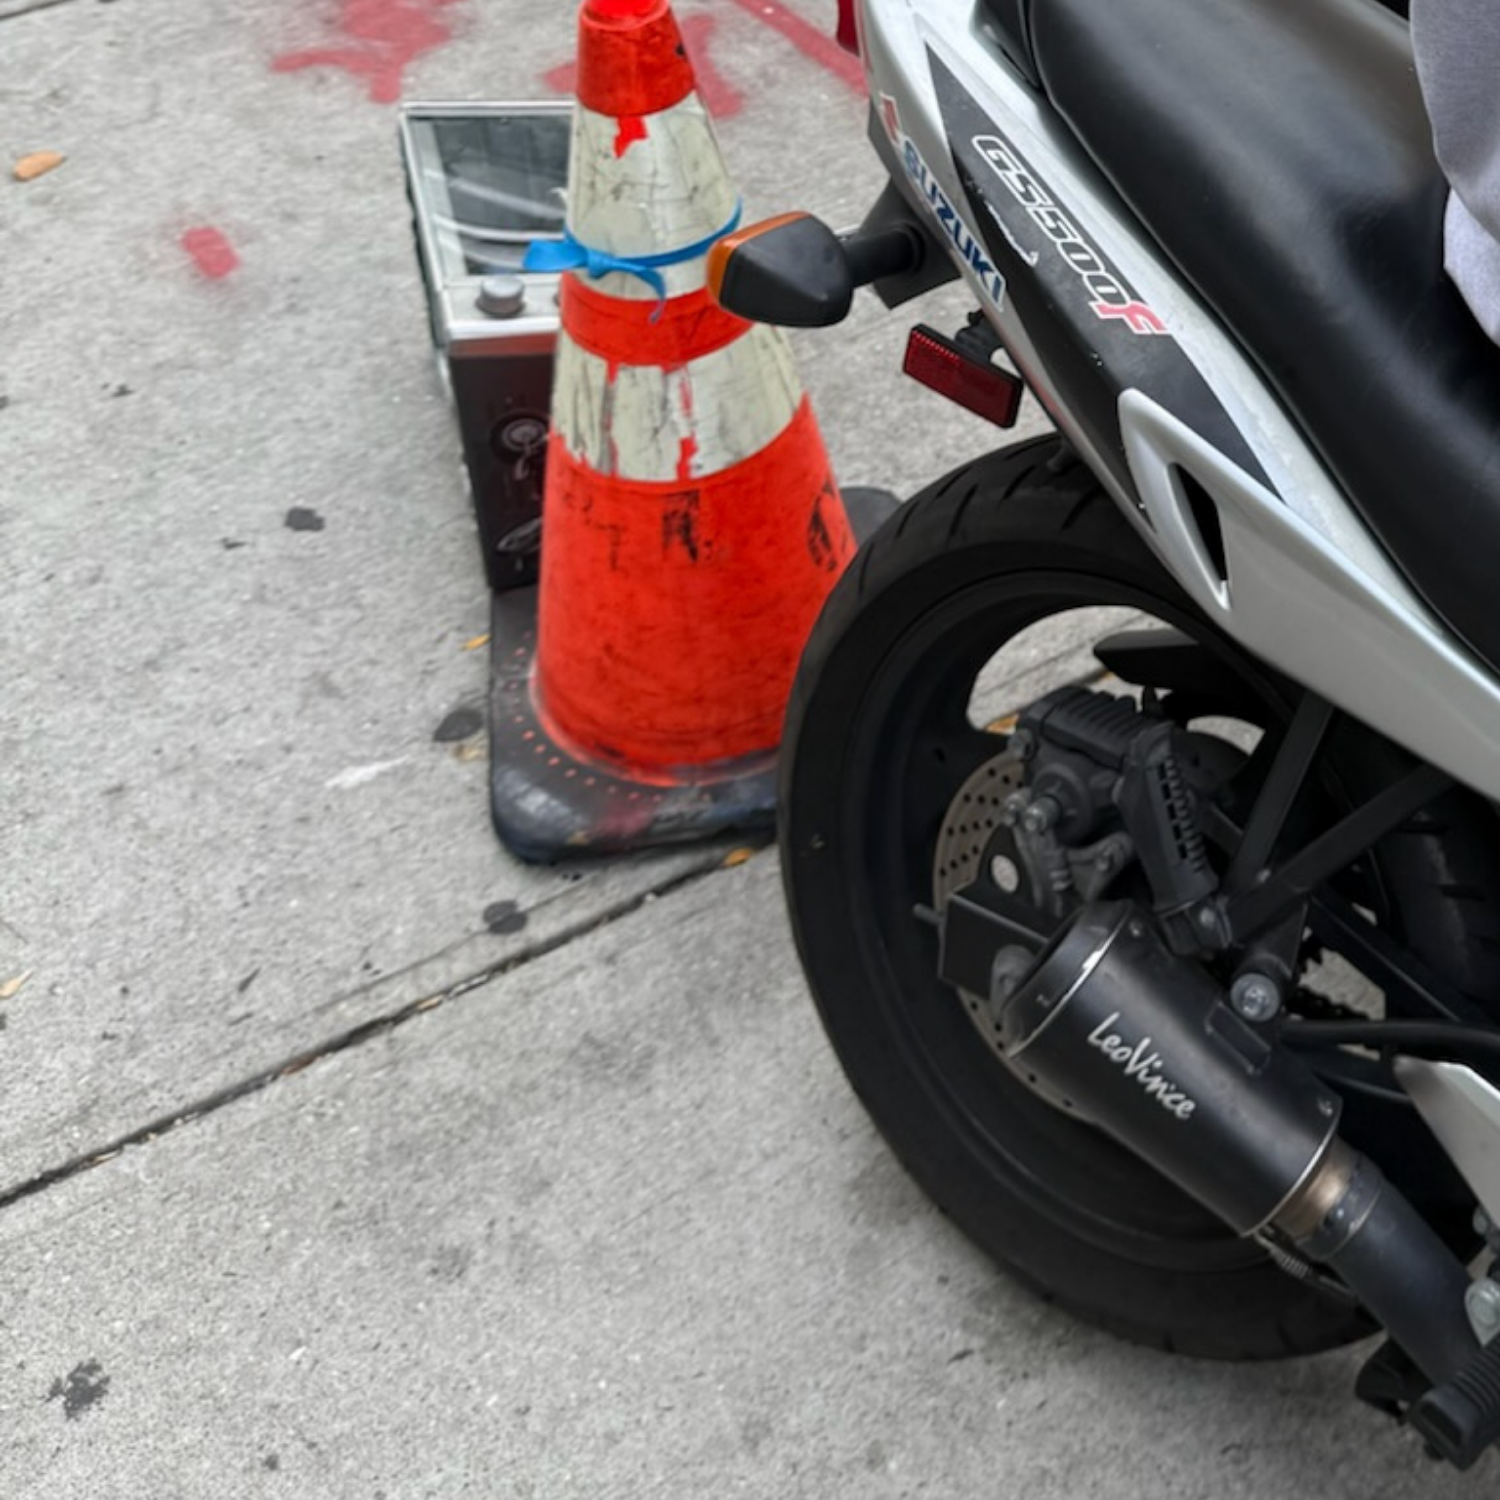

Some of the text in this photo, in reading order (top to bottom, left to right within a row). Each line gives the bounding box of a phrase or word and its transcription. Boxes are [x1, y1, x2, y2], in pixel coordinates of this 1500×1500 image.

[902, 137, 1004, 306] SUZUKI
[971, 135, 1170, 334] GS500F
[1087, 1011, 1196, 1119] LeoVince
